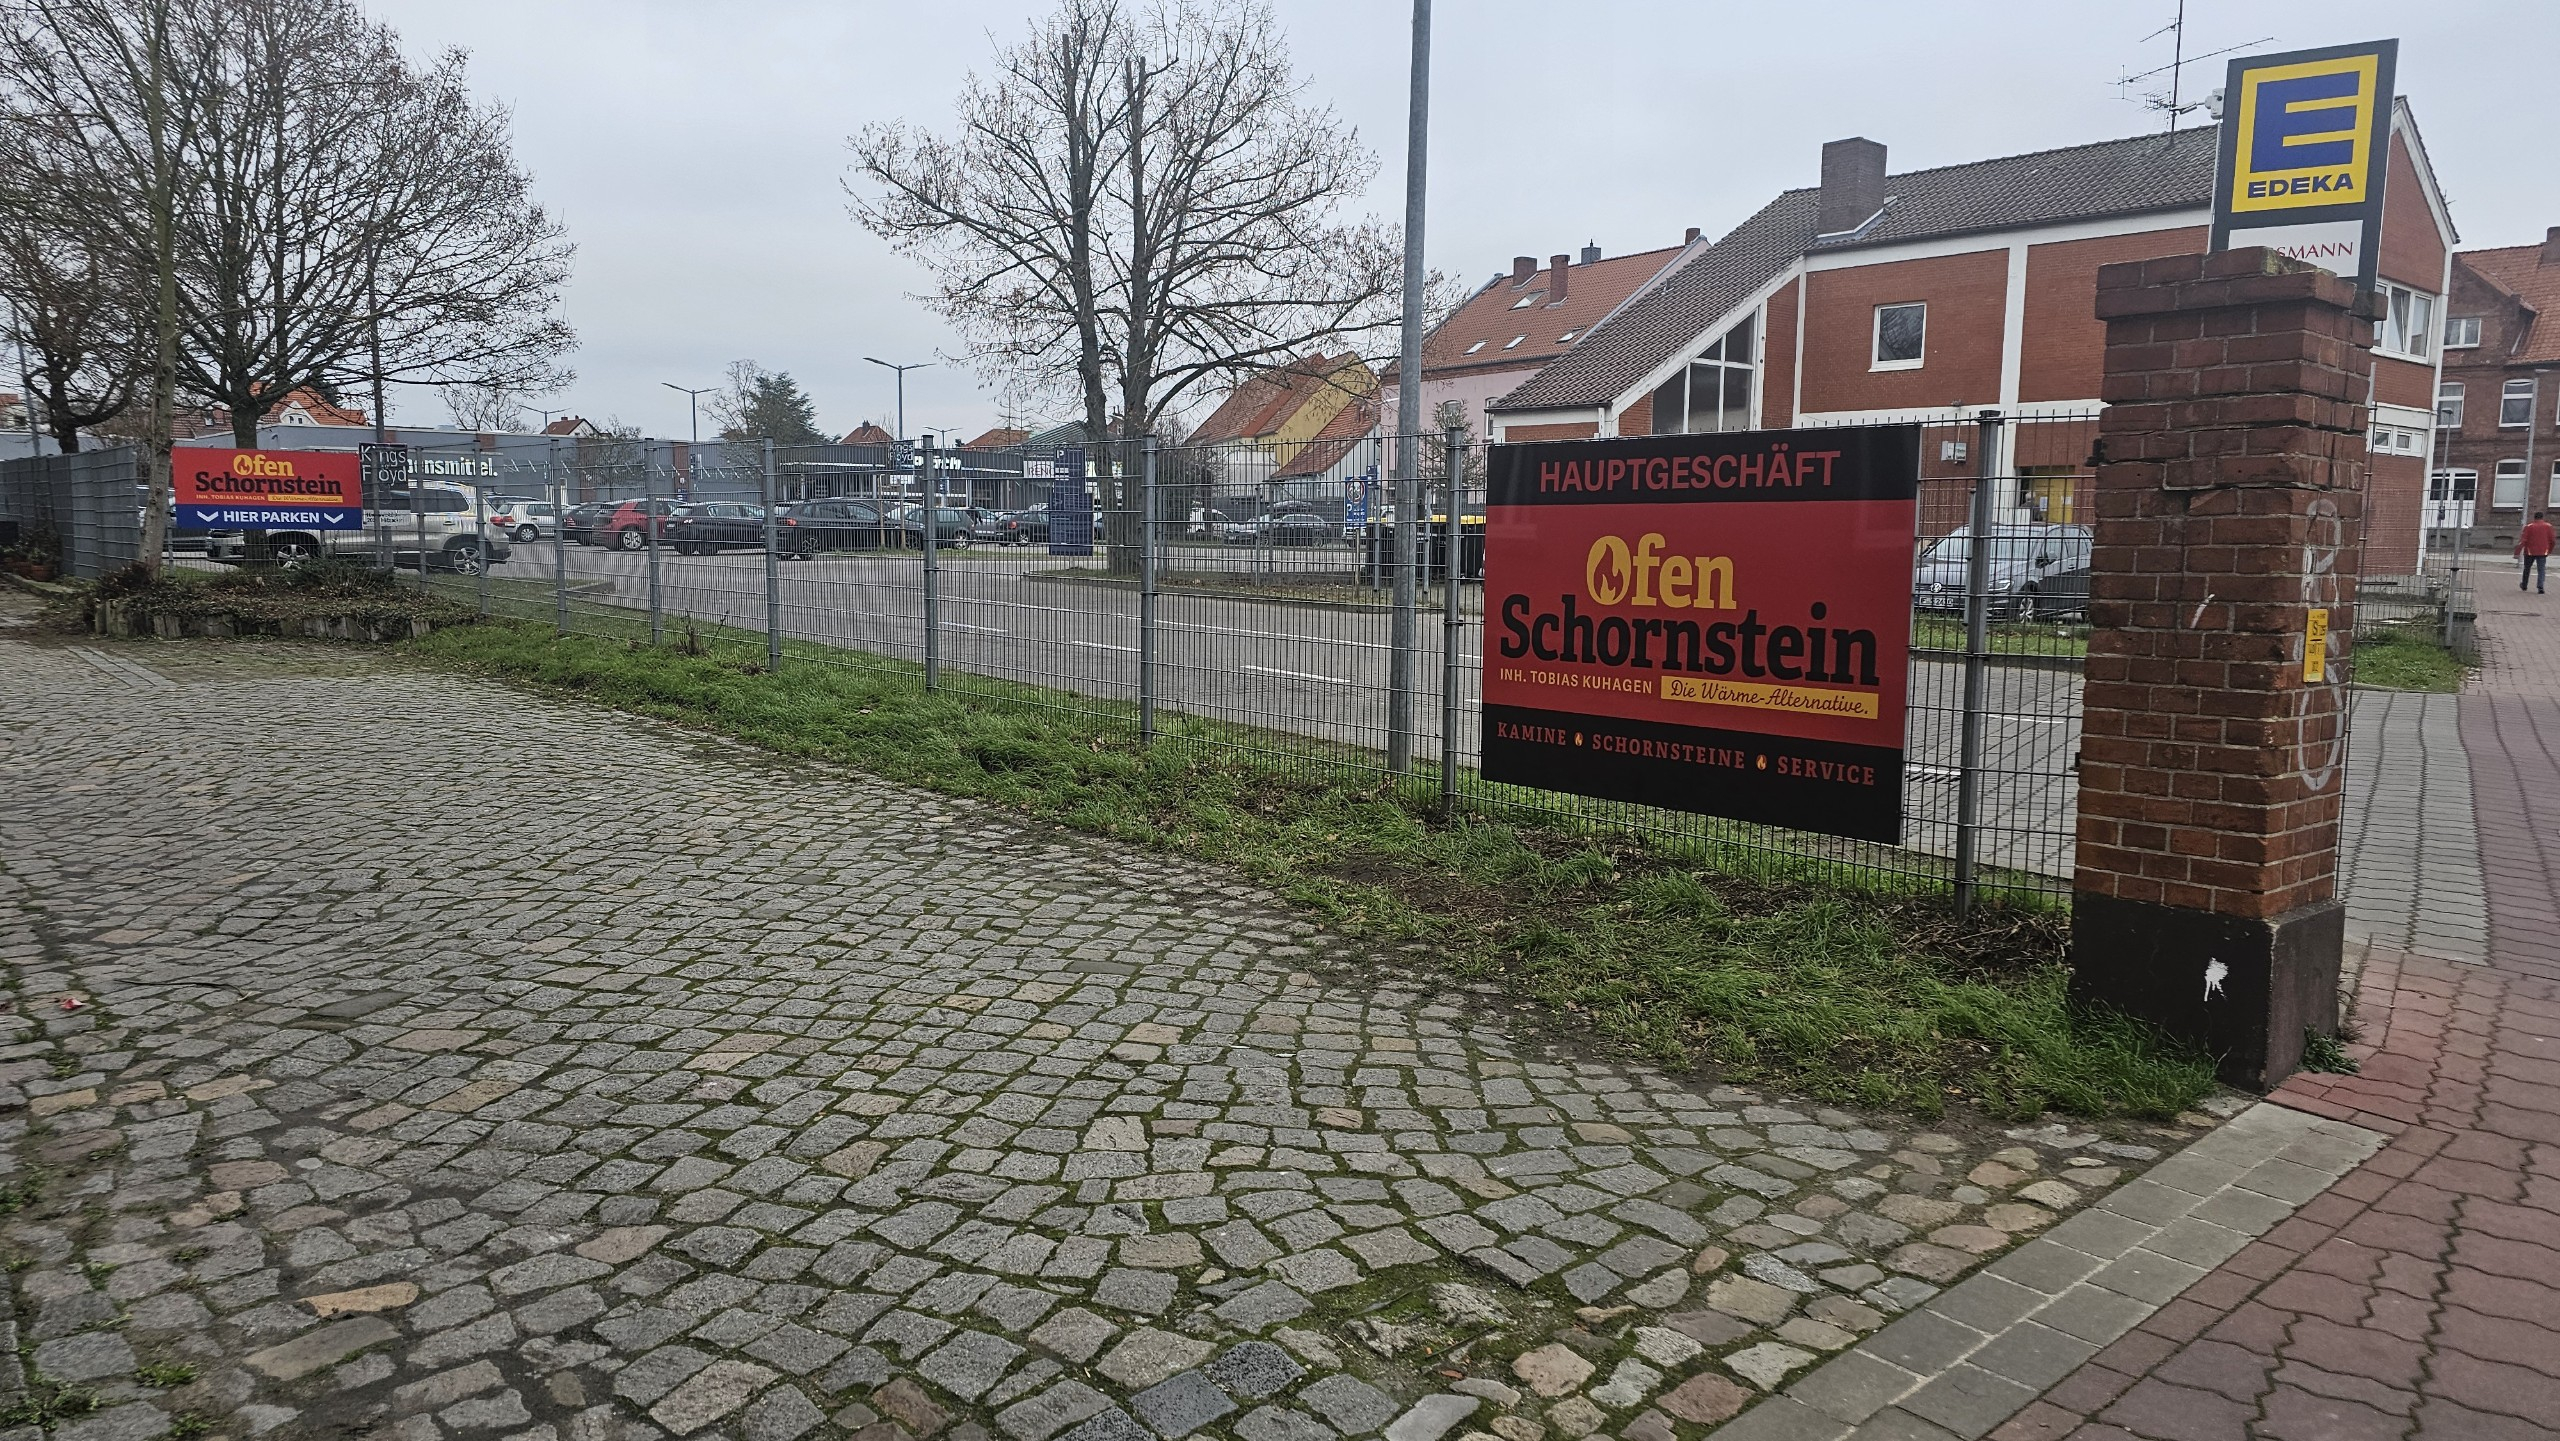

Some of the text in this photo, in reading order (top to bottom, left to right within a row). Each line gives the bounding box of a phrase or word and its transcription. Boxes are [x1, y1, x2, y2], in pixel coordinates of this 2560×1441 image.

[2247, 173, 2354, 199] EDEKA
[2276, 242, 2354, 259] SMANN
[233, 454, 294, 477] Ofen
[361, 445, 407, 467] Kngs
[1540, 443, 1841, 493] HAUPTGESCHÄFT
[195, 471, 342, 495] Schornstein
[362, 464, 407, 486] Foyd
[223, 510, 320, 523] HIER PARKEN
[1586, 532, 1737, 610] Ofen
[1500, 593, 1880, 686] Schornstein
[1500, 668, 1653, 695] INH. TOBIAS KUHAGEN
[1670, 680, 1869, 715] Die Wärme-Alternative.
[1497, 722, 1875, 786] KAMINE SCHORNSTEINE SERVICE
